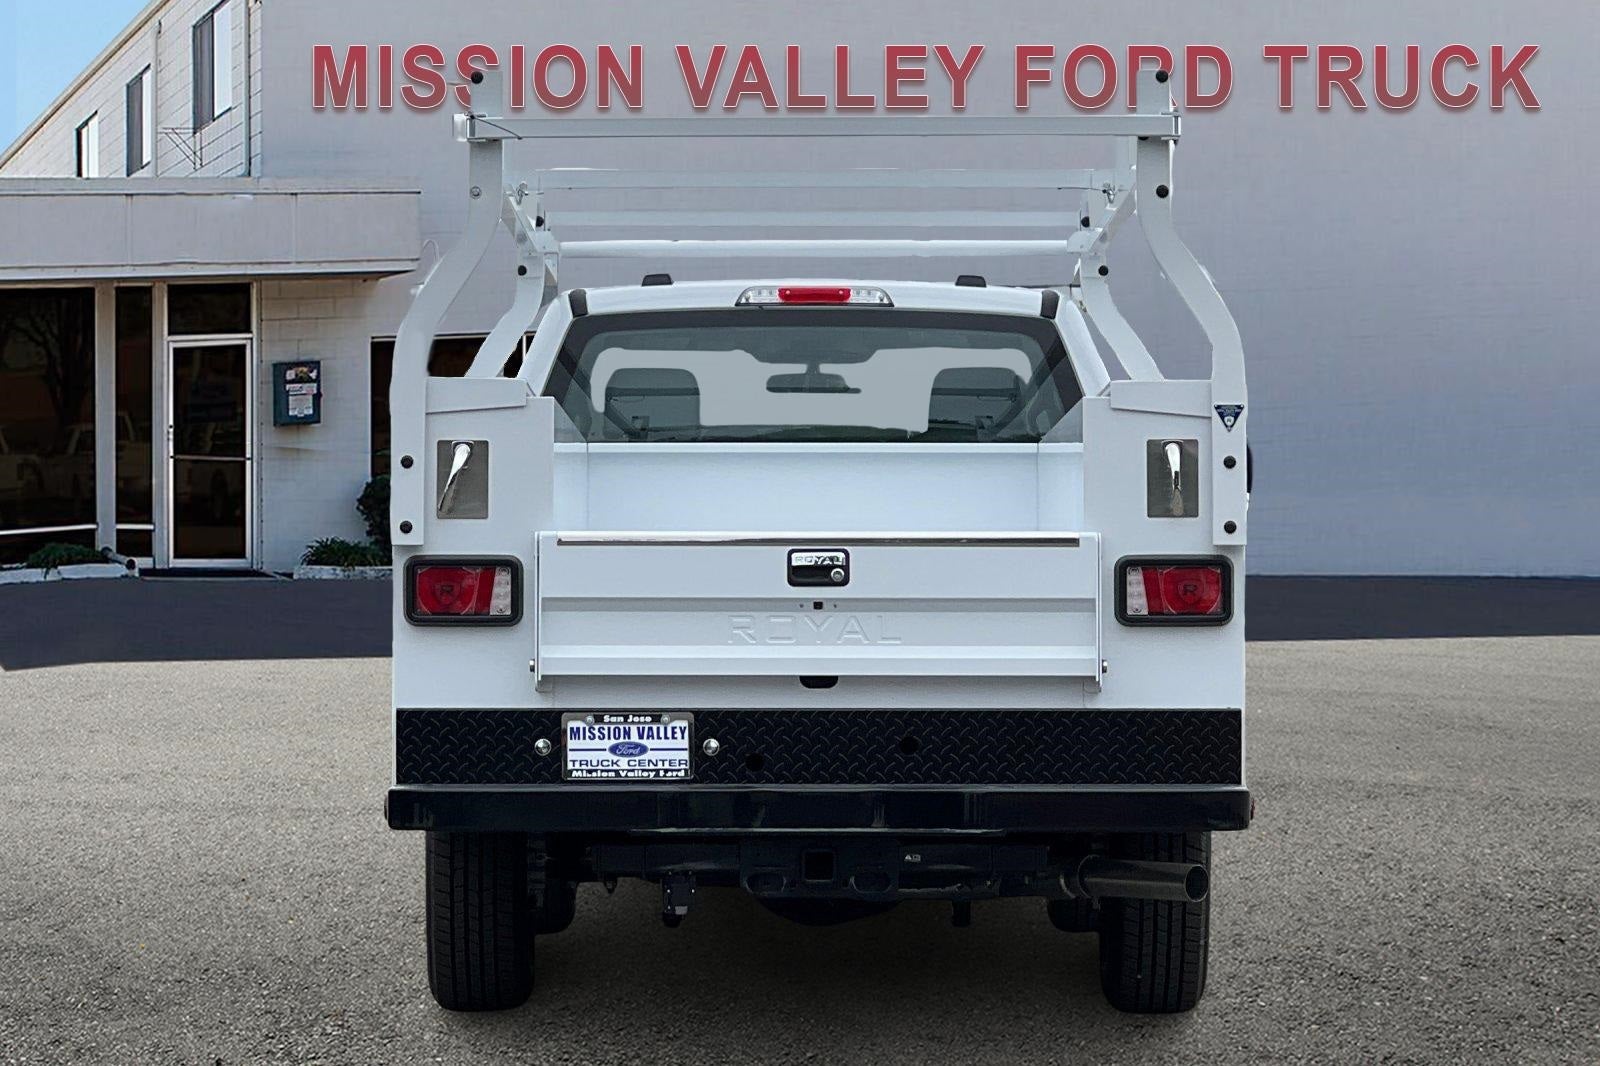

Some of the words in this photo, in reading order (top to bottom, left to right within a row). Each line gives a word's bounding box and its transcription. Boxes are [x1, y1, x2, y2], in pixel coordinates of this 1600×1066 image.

[312, 43, 643, 109] MISSION
[674, 44, 986, 108] VALLEY
[1263, 43, 1542, 109] TRUCK
[794, 554, 844, 566] ROYAL
[727, 614, 902, 644] ROYAL
[603, 714, 624, 723] San
[569, 726, 631, 741] MISSION
[637, 726, 687, 740] VALLEY
[615, 745, 641, 755] Ford
[569, 759, 620, 767] TRUCK
[627, 759, 688, 767] CENTER
[572, 769, 615, 777] Mission
[619, 769, 656, 779] Valley
